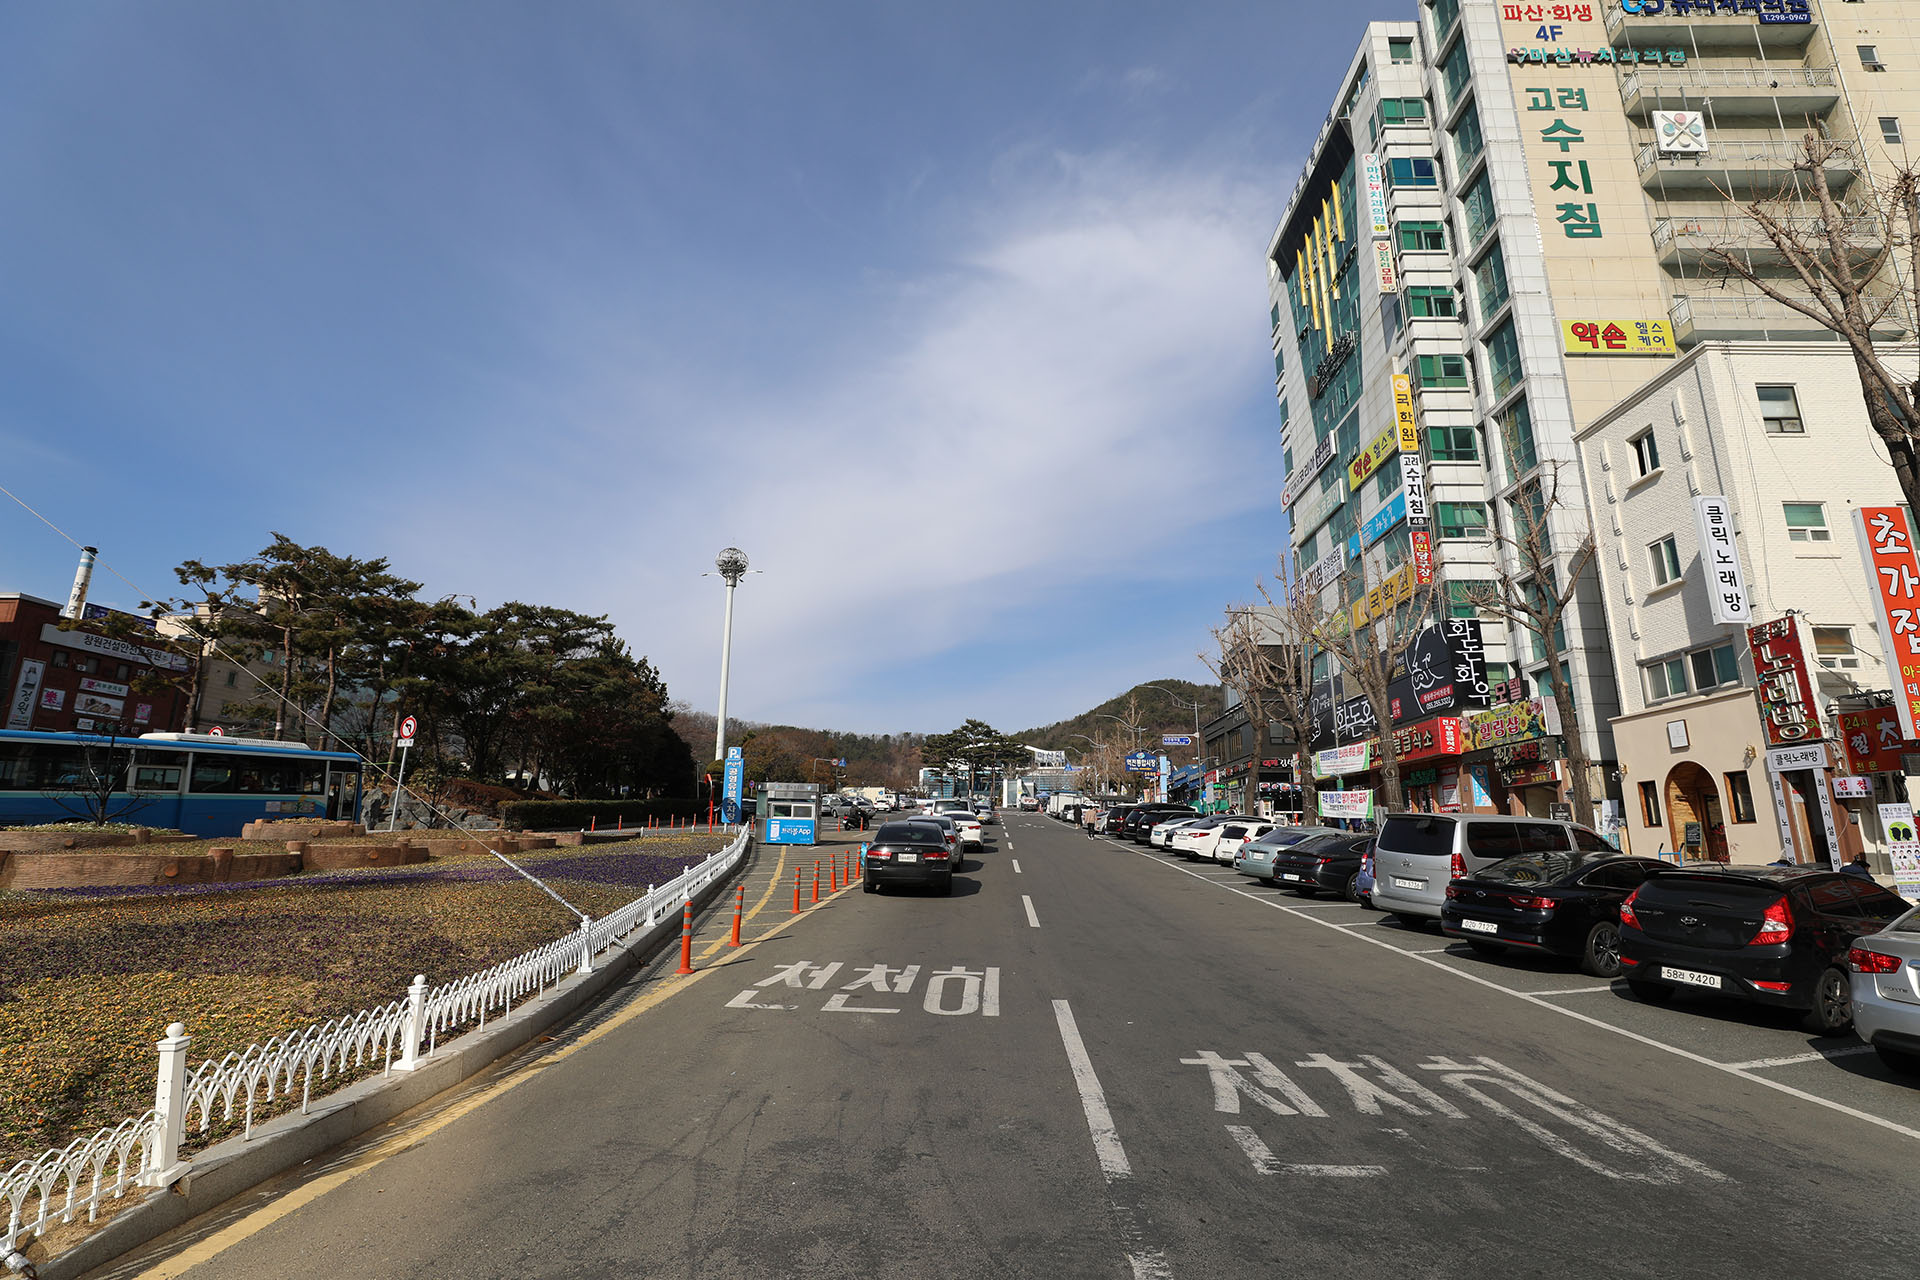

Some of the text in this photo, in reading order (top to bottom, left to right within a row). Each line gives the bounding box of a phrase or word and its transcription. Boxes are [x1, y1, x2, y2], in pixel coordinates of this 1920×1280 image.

[1504, 4, 1593, 22] 파산·회생
[1535, 25, 1563, 41] 4F
[1529, 47, 1687, 64] 마산뉴치과의원
[1525, 88, 1589, 111] 고려
[1540, 119, 1603, 238] 수지침
[1367, 166, 1386, 224] 마산뉴치과의원
[1571, 322, 1627, 349] 약손
[1634, 322, 1663, 335] 헬스
[1637, 335, 1666, 347] 케어
[1397, 393, 1415, 442] 국학원
[1353, 451, 1372, 480] 약손
[1373, 425, 1397, 460] 헬스케
[1404, 456, 1419, 466] 고려
[1406, 467, 1424, 515] 수지침
[1706, 505, 1742, 612] 클릭노래방
[1494, 677, 1521, 704] 모텔
[1760, 644, 1808, 740] 노래방
[1331, 700, 1380, 738] 화돈화
[1480, 715, 1519, 740] 힐링샵
[1775, 751, 1817, 765] 클릭노래방
[724, 960, 1000, 1017] 천천히
[1689, 973, 1716, 985] 9420
[1180, 1050, 1740, 1185] 천천히
